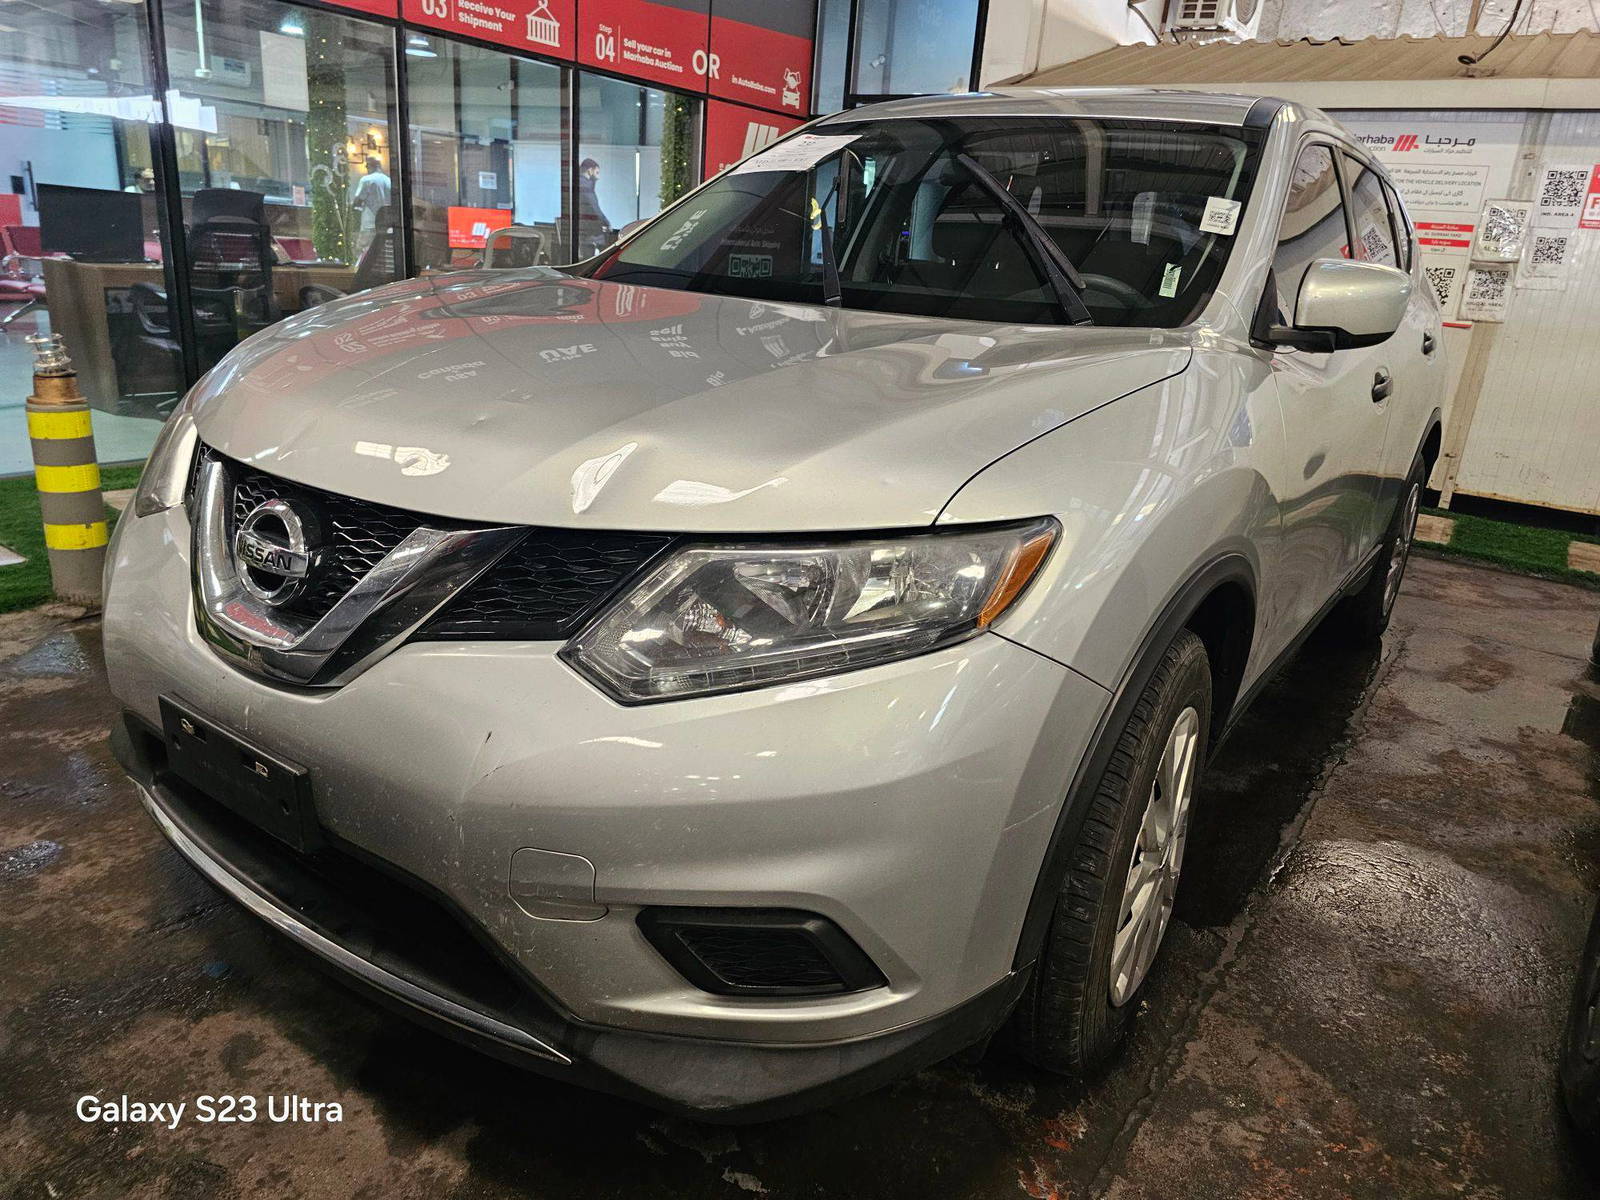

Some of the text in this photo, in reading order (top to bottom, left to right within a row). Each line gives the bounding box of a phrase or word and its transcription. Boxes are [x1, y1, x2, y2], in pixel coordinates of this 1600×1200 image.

[458, 0, 516, 21] Receive Your
[458, 11, 503, 32] Shipment
[599, 23, 613, 35] Step
[595, 33, 615, 62] 04
[623, 38, 672, 58] Sell your car in
[623, 50, 683, 73] Marhaba Auctions
[692, 49, 720, 80] OR
[239, 535, 293, 571] NISSAN
